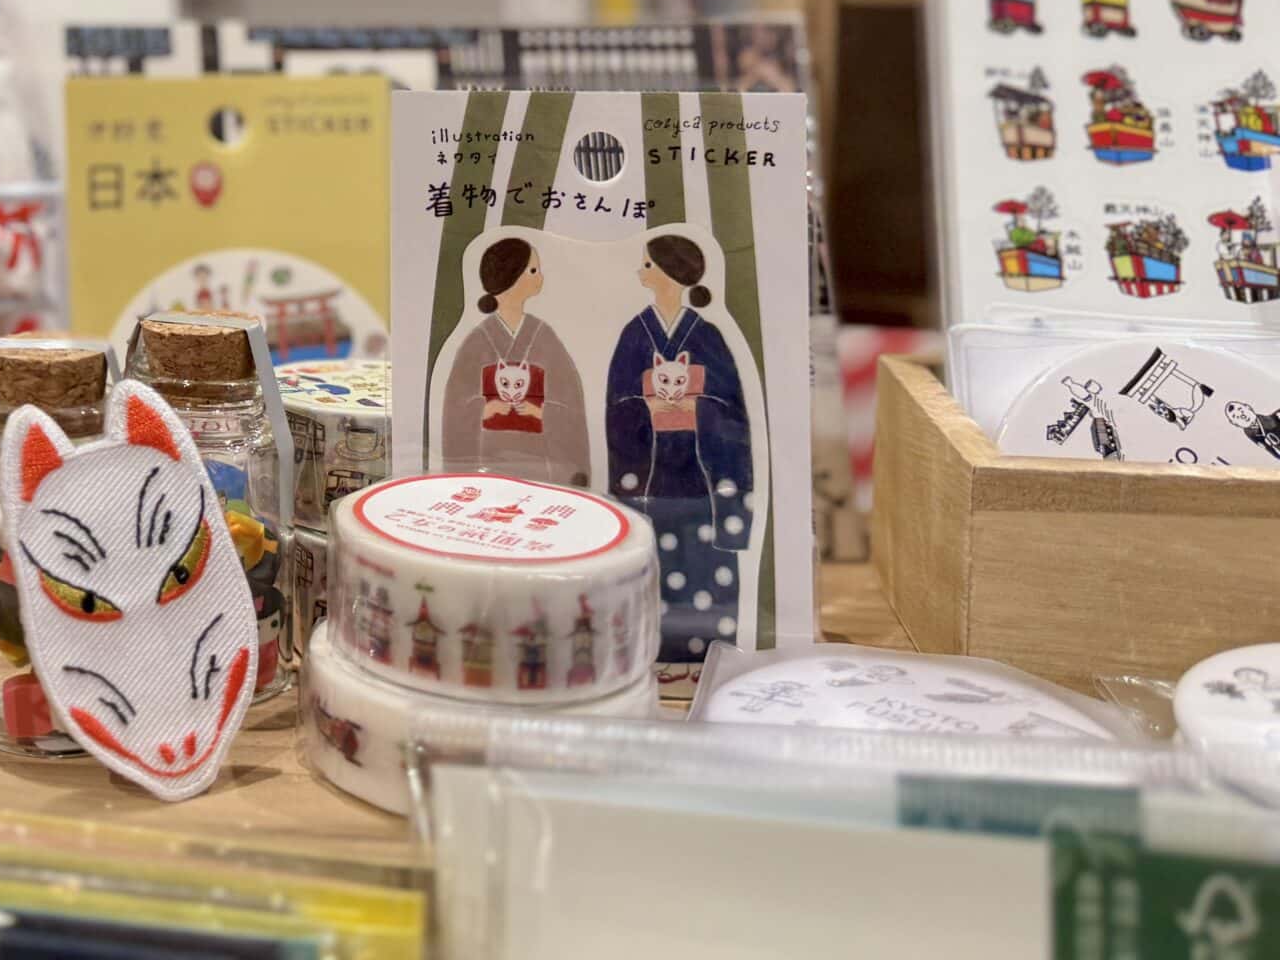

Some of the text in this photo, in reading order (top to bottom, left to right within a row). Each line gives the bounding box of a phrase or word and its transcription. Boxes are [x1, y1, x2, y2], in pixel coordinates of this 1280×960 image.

[707, 117, 781, 135] products
[431, 127, 535, 145] illustration
[648, 147, 777, 168] STICKER
[426, 182, 656, 220] 着物でおさんぽ
